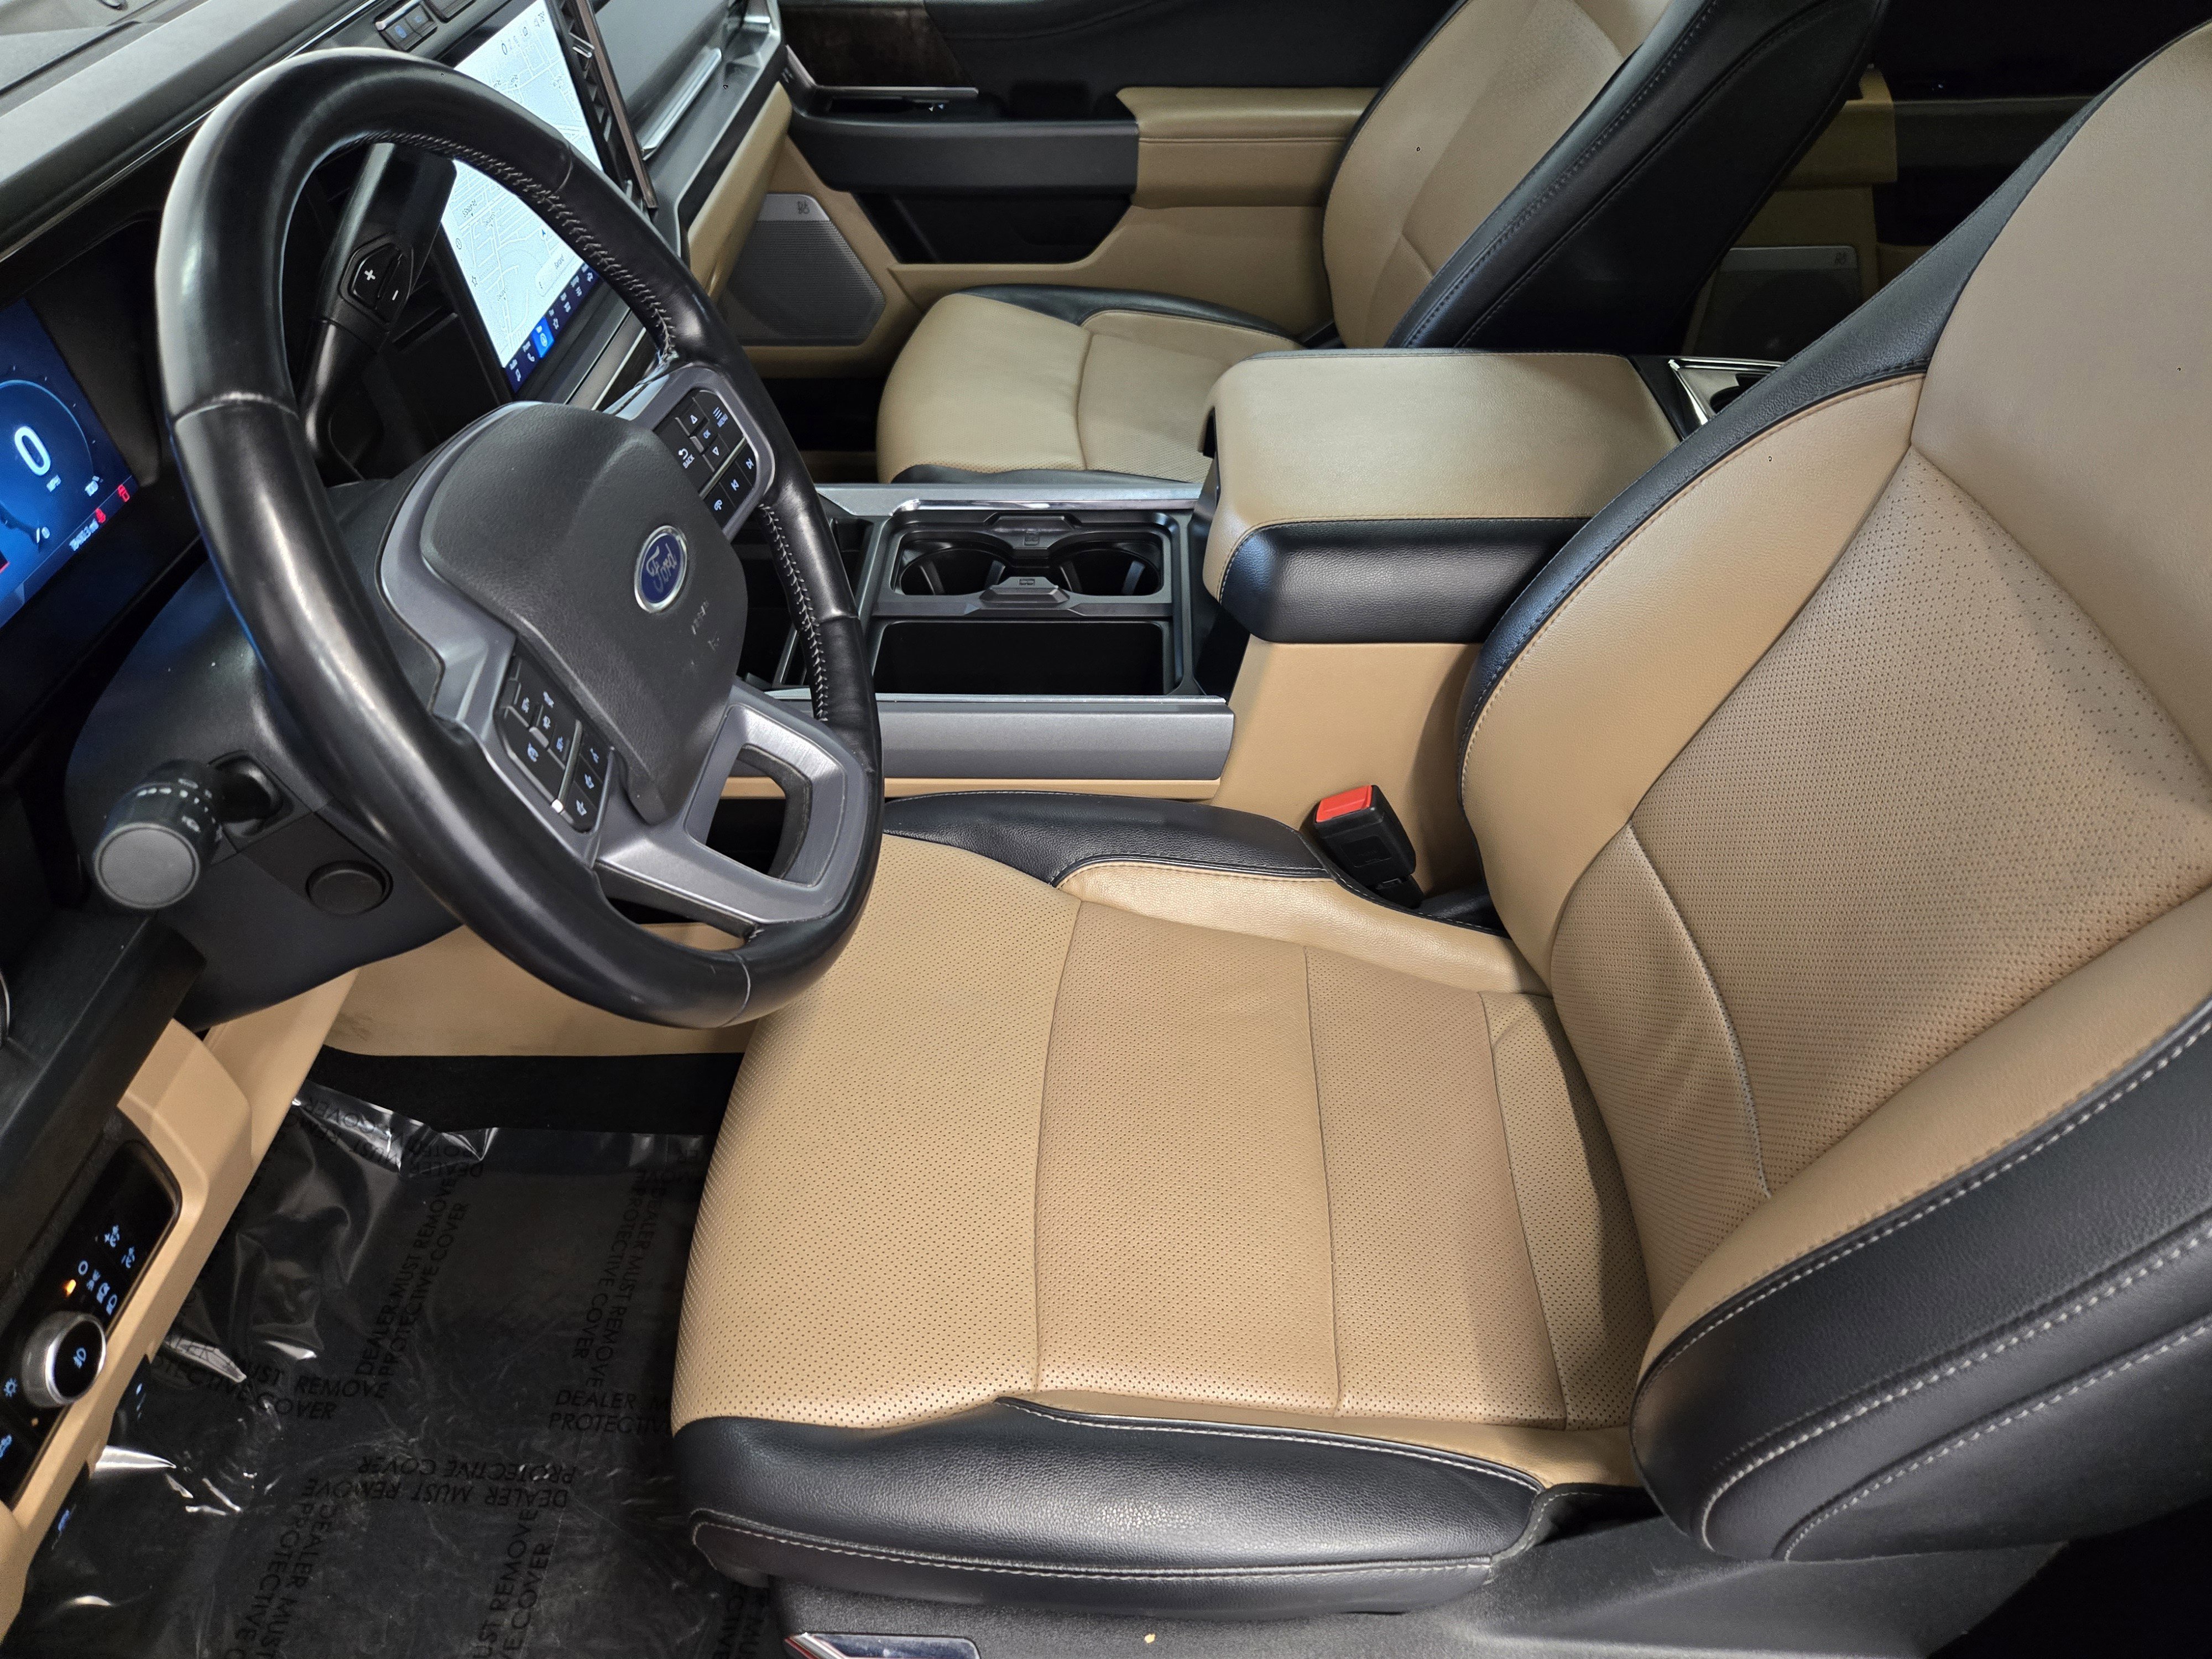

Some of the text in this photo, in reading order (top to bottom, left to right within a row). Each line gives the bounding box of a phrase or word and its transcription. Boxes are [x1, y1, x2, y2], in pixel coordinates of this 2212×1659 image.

[14, 426, 51, 476] 0
[703, 429, 711, 440] OK
[682, 454, 695, 469] BACK
[646, 544, 677, 593] Ford
[355, 1303, 399, 1375] DEALER
[389, 1254, 421, 1298] MUST
[413, 1178, 457, 1249] REMOVE
[378, 1265, 440, 1376] PROTECTIVE
[430, 1202, 469, 1262] COVER
[572, 1186, 646, 1359] PROTECTIVE COVER
[586, 1188, 665, 1387] DEALER MUST REMOVE
[257, 1392, 338, 1420] COVER
[294, 1375, 388, 1399] REMOVE
[556, 1389, 637, 1410] DEALER
[301, 1478, 569, 1508] DEALER MUST REMOVE
[358, 1455, 577, 1484] PROTECTIVE COVER
[471, 1619, 501, 1659] UST
[489, 1509, 539, 1611] REMOVE
[510, 1543, 554, 1629] COVER
